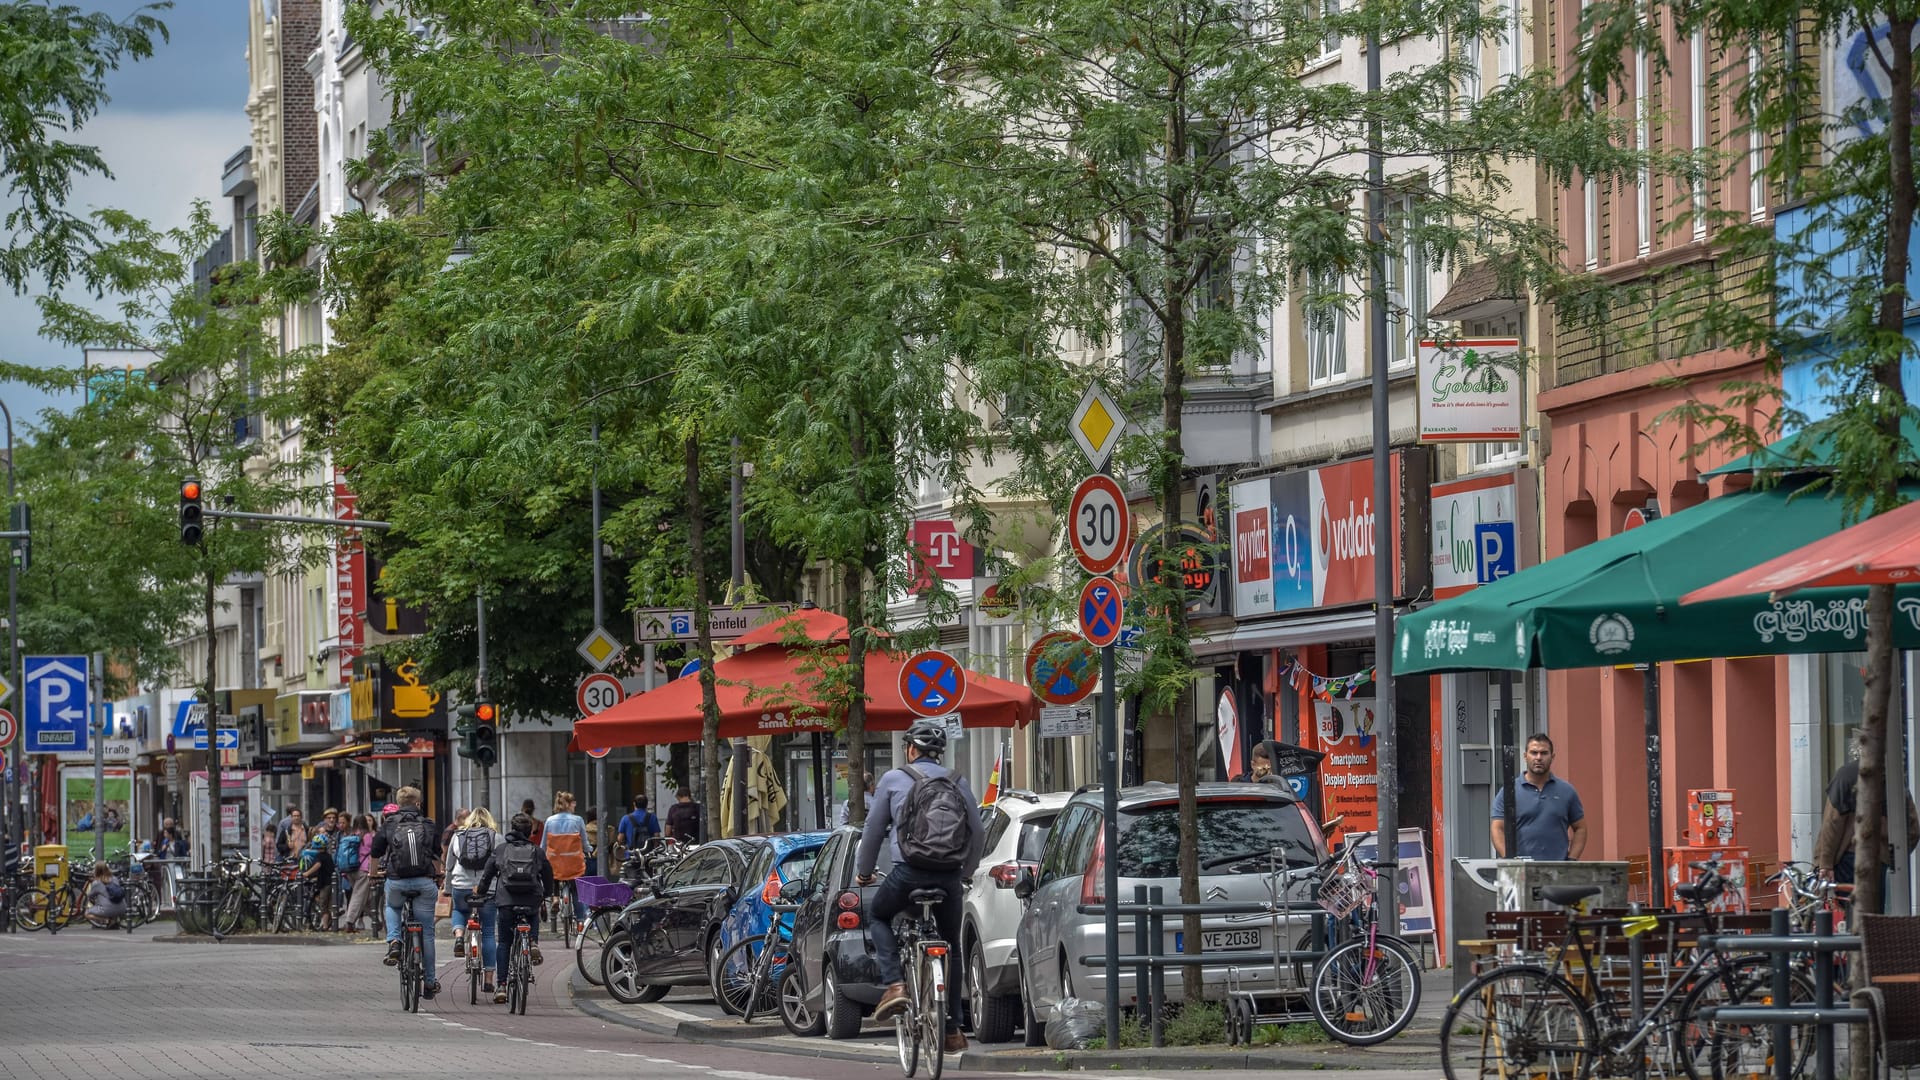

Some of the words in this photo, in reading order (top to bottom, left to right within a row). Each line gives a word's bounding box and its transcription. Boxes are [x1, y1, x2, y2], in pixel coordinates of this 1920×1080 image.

[1082, 503, 1115, 547] 30
[1332, 496, 1376, 561] vodafo
[930, 532, 960, 568] T
[1481, 532, 1503, 582] P
[1754, 598, 1869, 643] çiğköft
[40, 678, 71, 723] P
[588, 687, 614, 708] 30
[0, 720, 8, 736] 0
[758, 712, 788, 729] simit
[1322, 721, 1332, 732] 30
[1330, 752, 1368, 768] Smartphone
[1324, 773, 1346, 788] Display
[1204, 934, 1222, 948] YE
[1225, 932, 1258, 946] 2038
